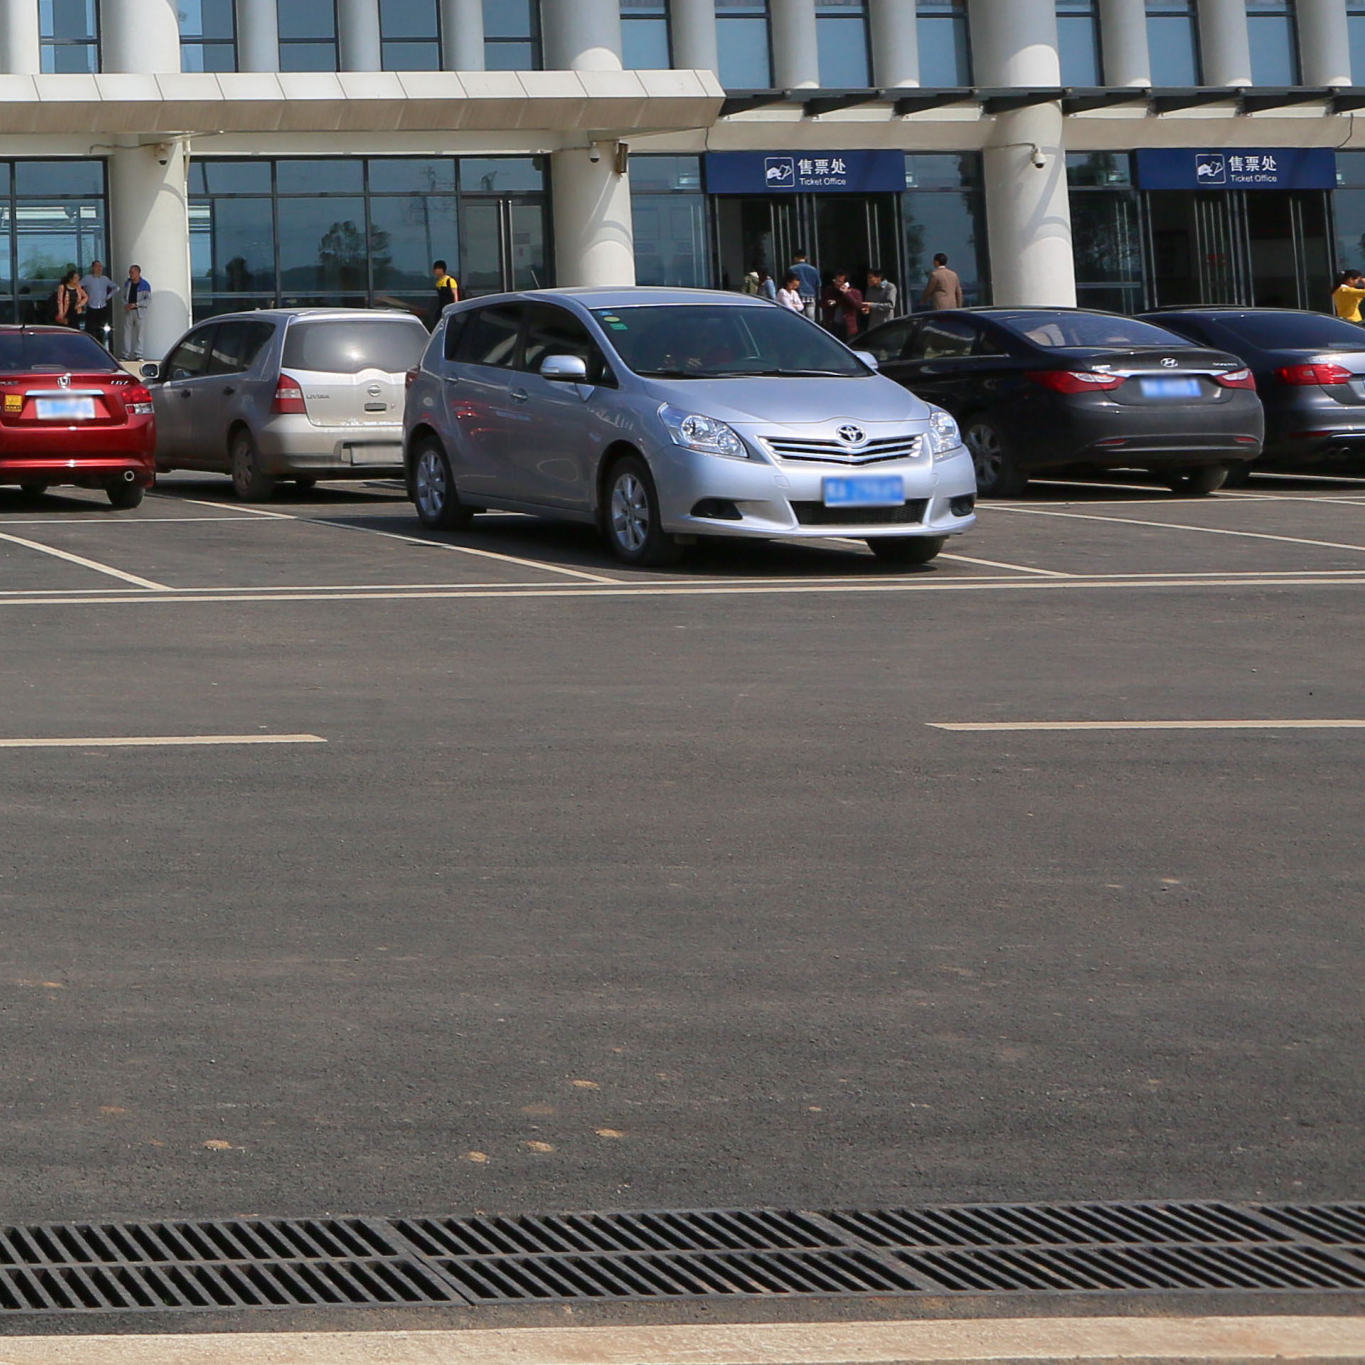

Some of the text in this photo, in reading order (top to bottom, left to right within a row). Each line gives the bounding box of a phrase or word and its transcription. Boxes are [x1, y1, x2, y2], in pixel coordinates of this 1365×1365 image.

[797, 158, 846, 175] 售票处
[1228, 155, 1277, 172] 售票处
[799, 177, 846, 186] Ticket Office
[1230, 174, 1277, 183] Ticket Office
